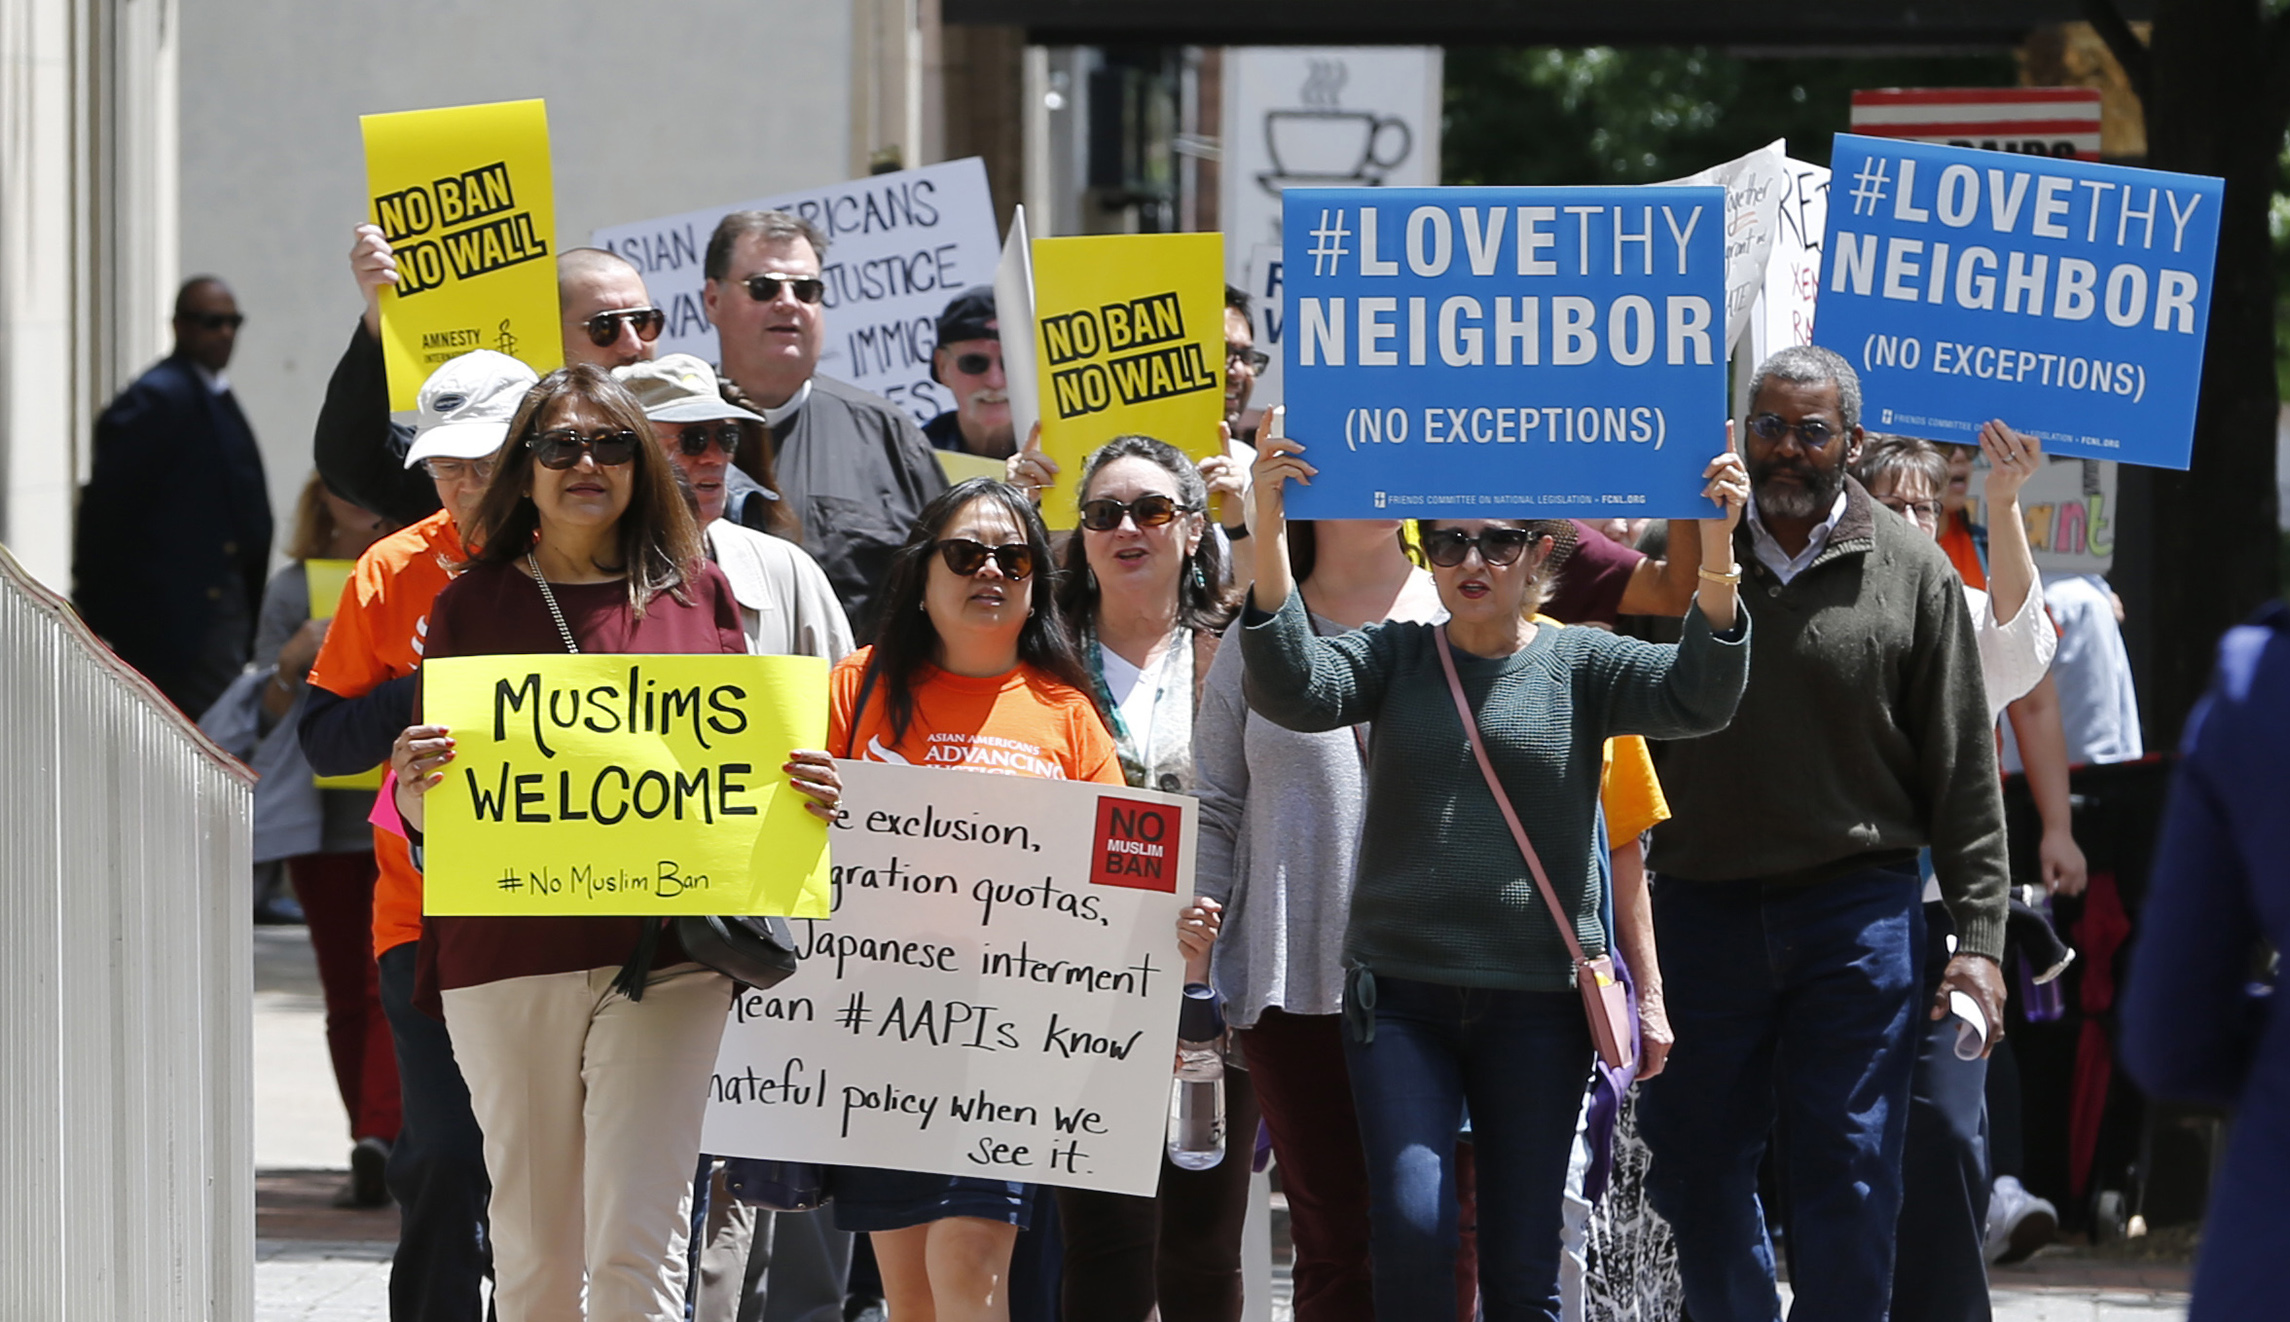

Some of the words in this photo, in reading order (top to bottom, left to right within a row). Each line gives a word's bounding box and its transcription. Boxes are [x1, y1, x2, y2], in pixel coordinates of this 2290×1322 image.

[375, 187, 432, 242] NO
[434, 162, 515, 226] BAN
[1849, 156, 2202, 253] #LOVETHY
[394, 241, 446, 298] NO
[443, 212, 548, 279] WALL
[1307, 205, 1703, 278] #LOVETHY
[822, 244, 964, 309] JUSTICE
[1831, 231, 2199, 334] NEIGHBOR
[422, 329, 481, 349] AMNESTY
[1042, 310, 1099, 365] NO
[1101, 291, 1185, 352] BAN
[1299, 294, 1714, 368] NEIGHBOR
[1053, 363, 1111, 419] NO
[1108, 342, 1217, 405] WALL
[1862, 333, 1922, 371] (NO
[1933, 341, 2146, 404] EXCEPTIONS)
[1345, 407, 1409, 451] (NO
[1424, 406, 1666, 451] EXCEPTIONS)
[1894, 413, 1927, 426] FRIENDS
[1927, 417, 1973, 431] COMMITTEE
[2081, 435, 2121, 449] FCNL.ORG
[1388, 495, 1425, 505] FRIENDS
[1426, 495, 1477, 505] COMMITTEE
[1478, 495, 1492, 505] ON
[1493, 495, 1535, 505] NATIONAL
[1537, 495, 1592, 505] LEGISLATION
[1601, 494, 1647, 505] FCNL.ORG
[494, 665, 747, 758] Muslims
[927, 733, 965, 743] ASIAN
[967, 734, 1041, 756] AMERICANS
[465, 761, 758, 826] WELCOME
[866, 805, 1042, 851] exclusion,
[1107, 839, 1164, 858] MUSLIM
[1110, 806, 1165, 842] NO
[571, 865, 648, 900] Muslim
[655, 861, 710, 897] Ban
[1105, 853, 1163, 879] BAN
[972, 876, 1109, 927] quotas,
[790, 917, 960, 979] Japanese
[981, 941, 1162, 998] interment
[1043, 1013, 1144, 1060] know
[841, 1083, 939, 1138] policy
[949, 1089, 1038, 1127] when
[1053, 1105, 1109, 1135] we
[967, 1136, 1034, 1167] see
[1050, 1137, 1095, 1175] it.
